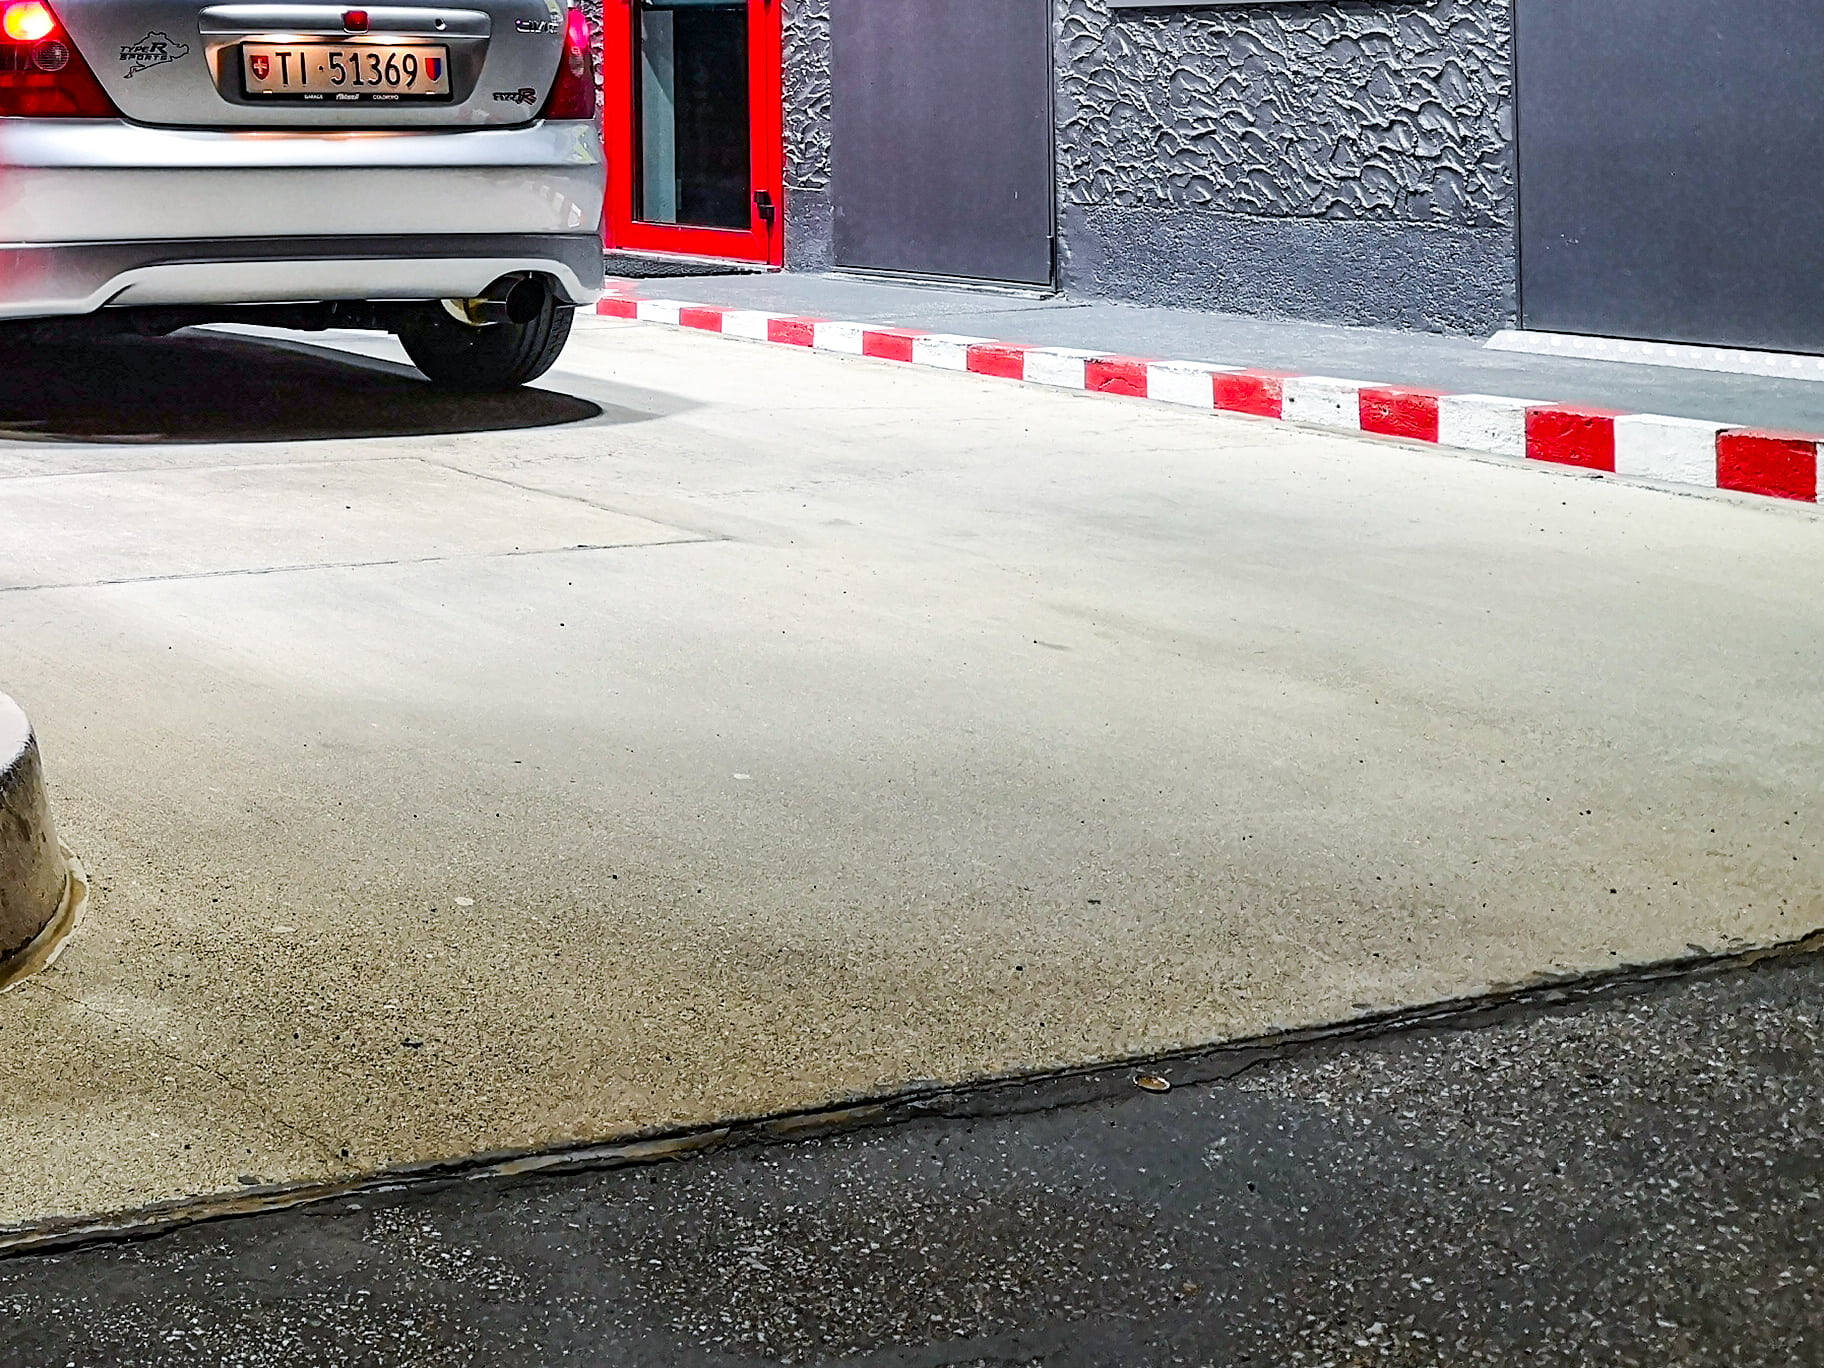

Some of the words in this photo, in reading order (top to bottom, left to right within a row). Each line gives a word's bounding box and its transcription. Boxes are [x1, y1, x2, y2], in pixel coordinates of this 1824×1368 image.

[149, 42, 168, 55] R
[276, 52, 307, 85] TI
[329, 51, 418, 88] 51369
